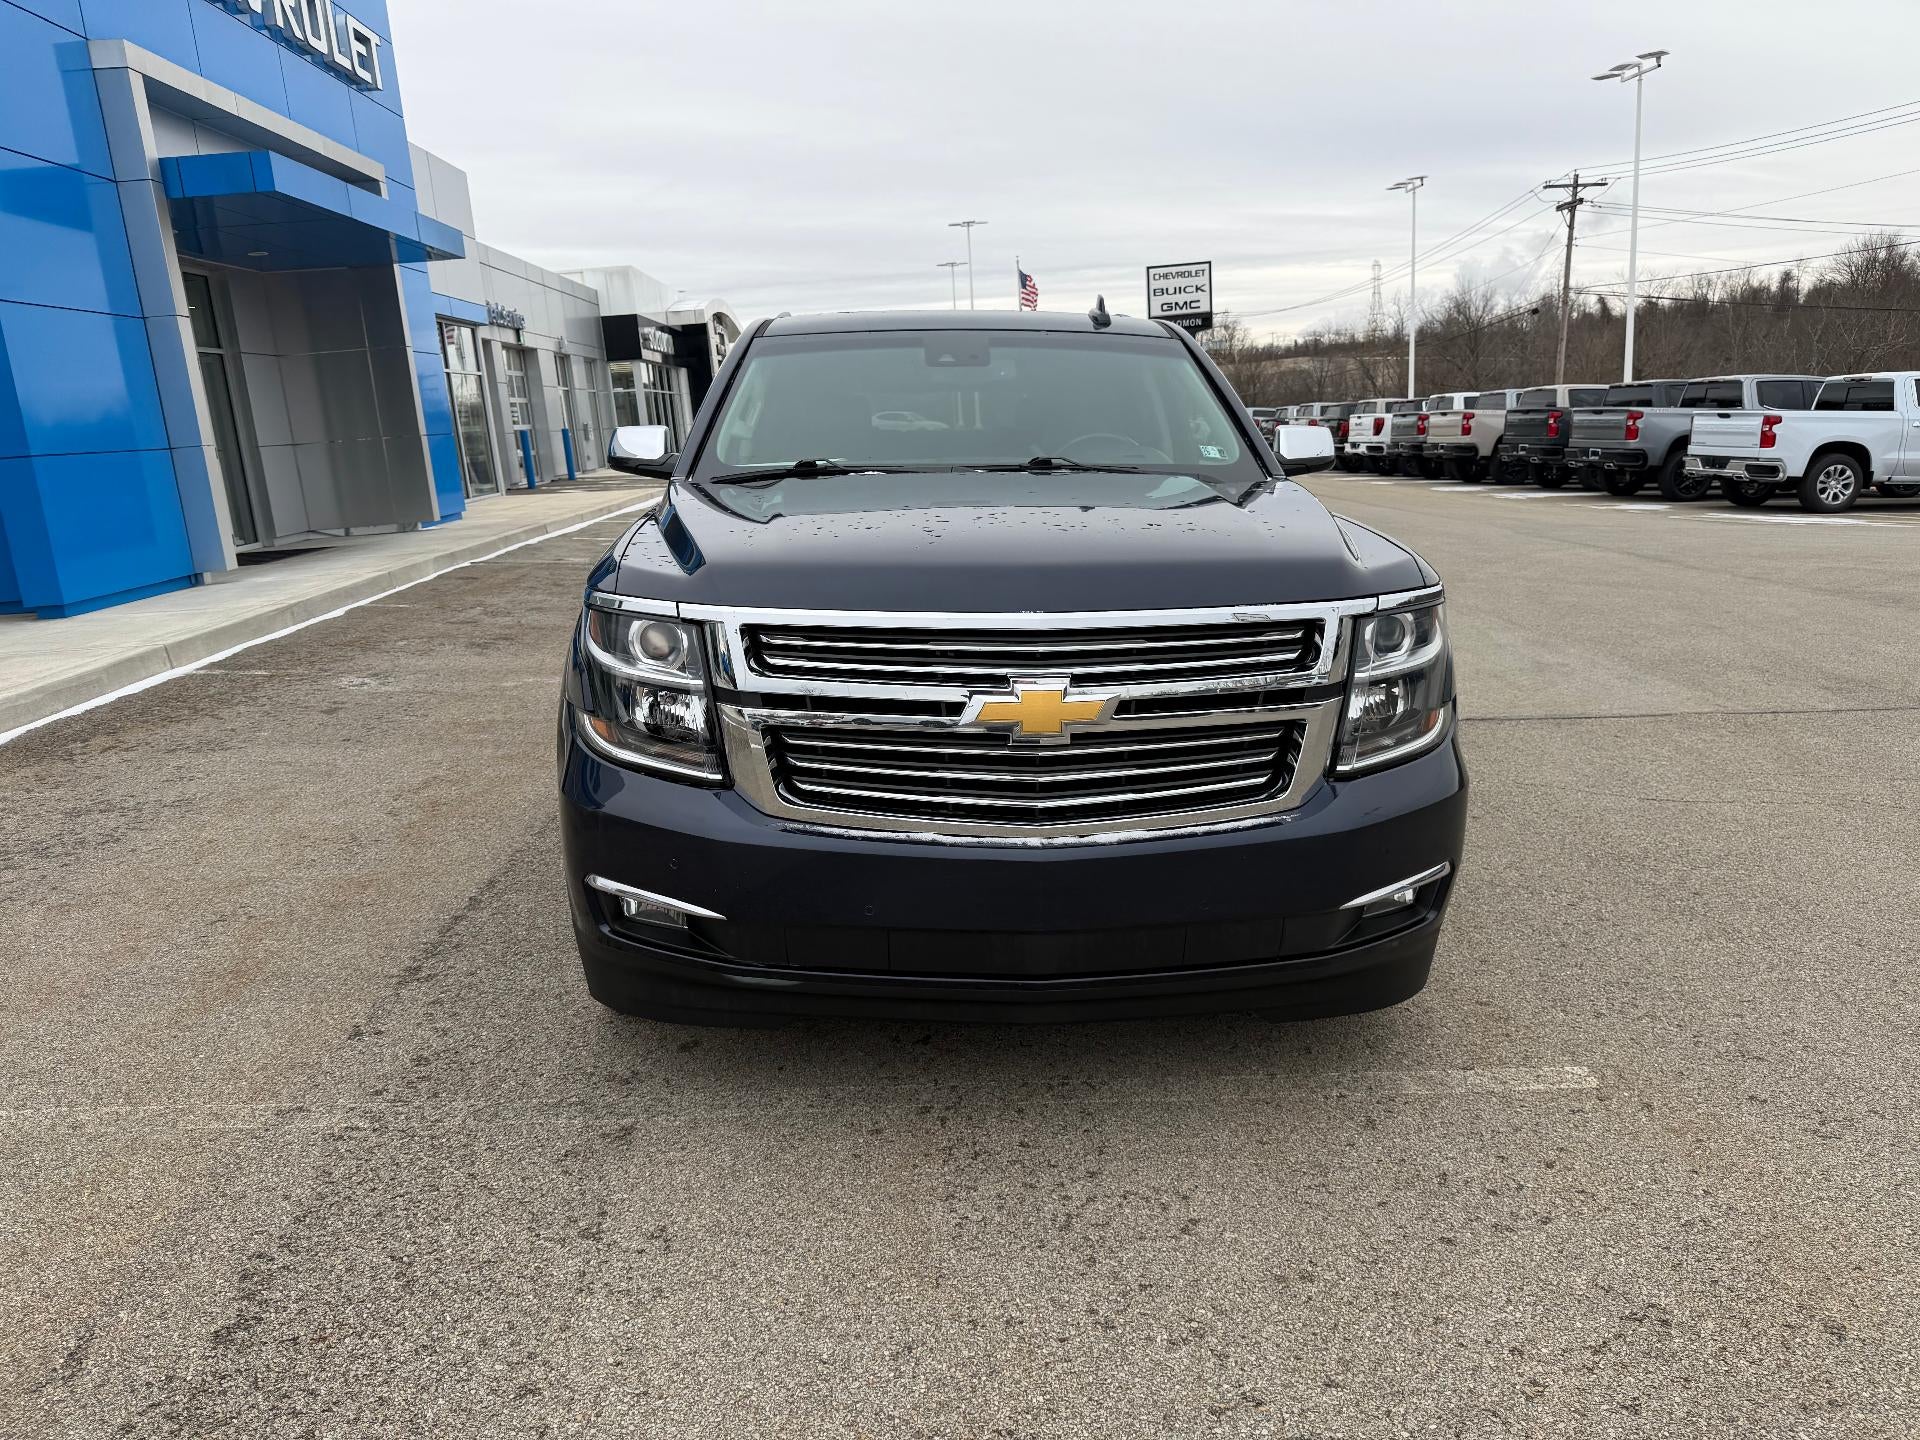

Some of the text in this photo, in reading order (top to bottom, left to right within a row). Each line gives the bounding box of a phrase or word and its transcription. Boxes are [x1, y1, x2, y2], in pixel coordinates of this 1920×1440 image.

[244, 0, 383, 91] ROLET
[1153, 269, 1206, 281] CHEVROLET
[1153, 284, 1207, 296] BUICK
[1161, 300, 1201, 312] GMC
[1173, 318, 1202, 327] OMON
